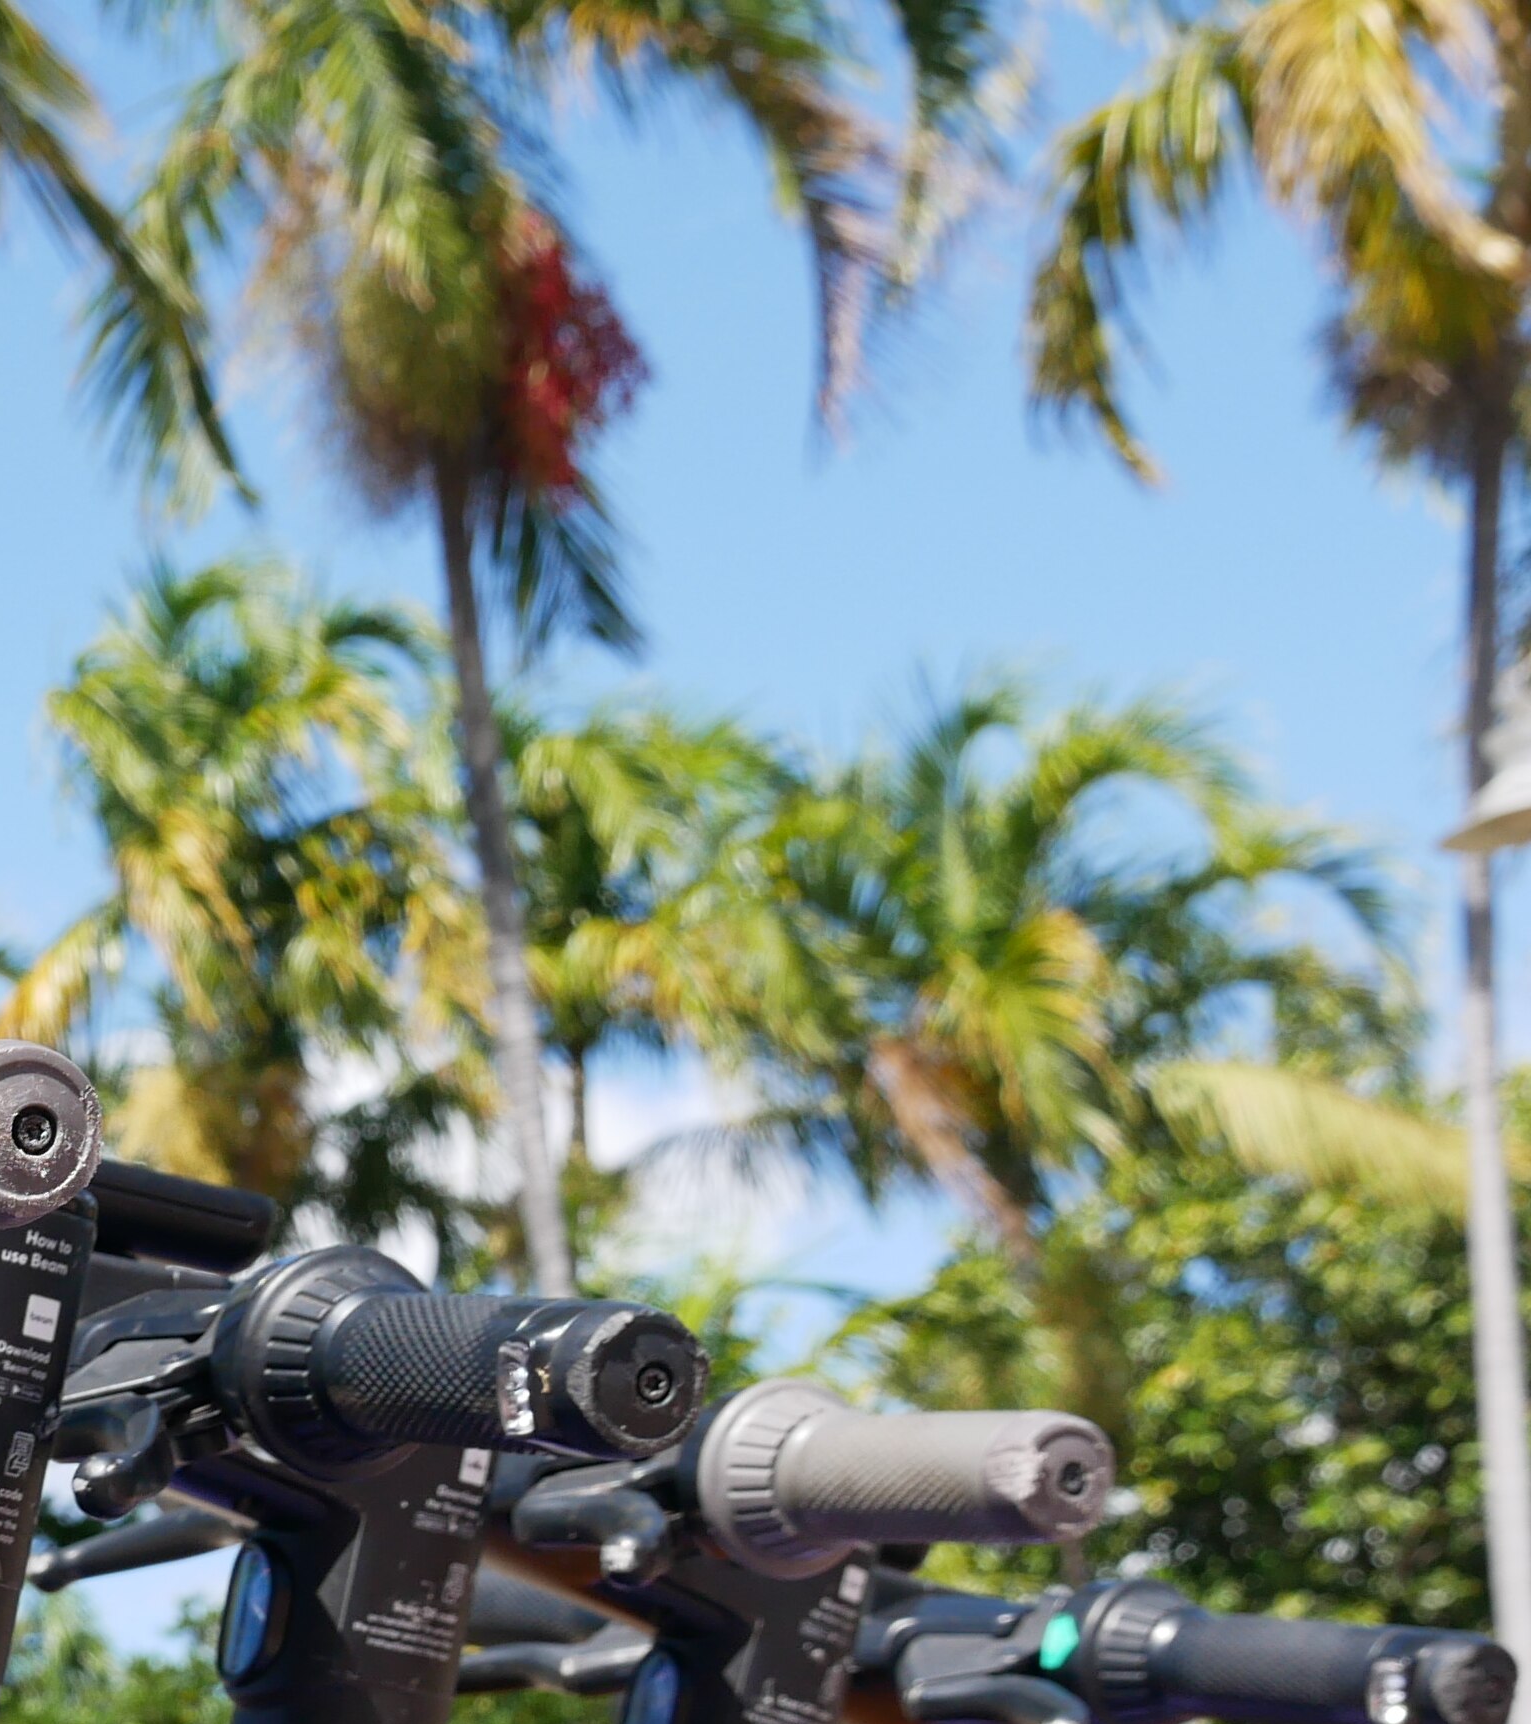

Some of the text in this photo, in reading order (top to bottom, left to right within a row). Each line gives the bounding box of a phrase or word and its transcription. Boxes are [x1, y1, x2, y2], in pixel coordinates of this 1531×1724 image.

[25, 1229, 72, 1255] How to
[1, 1249, 68, 1276] use Beam
[0, 1488, 24, 1501] code
